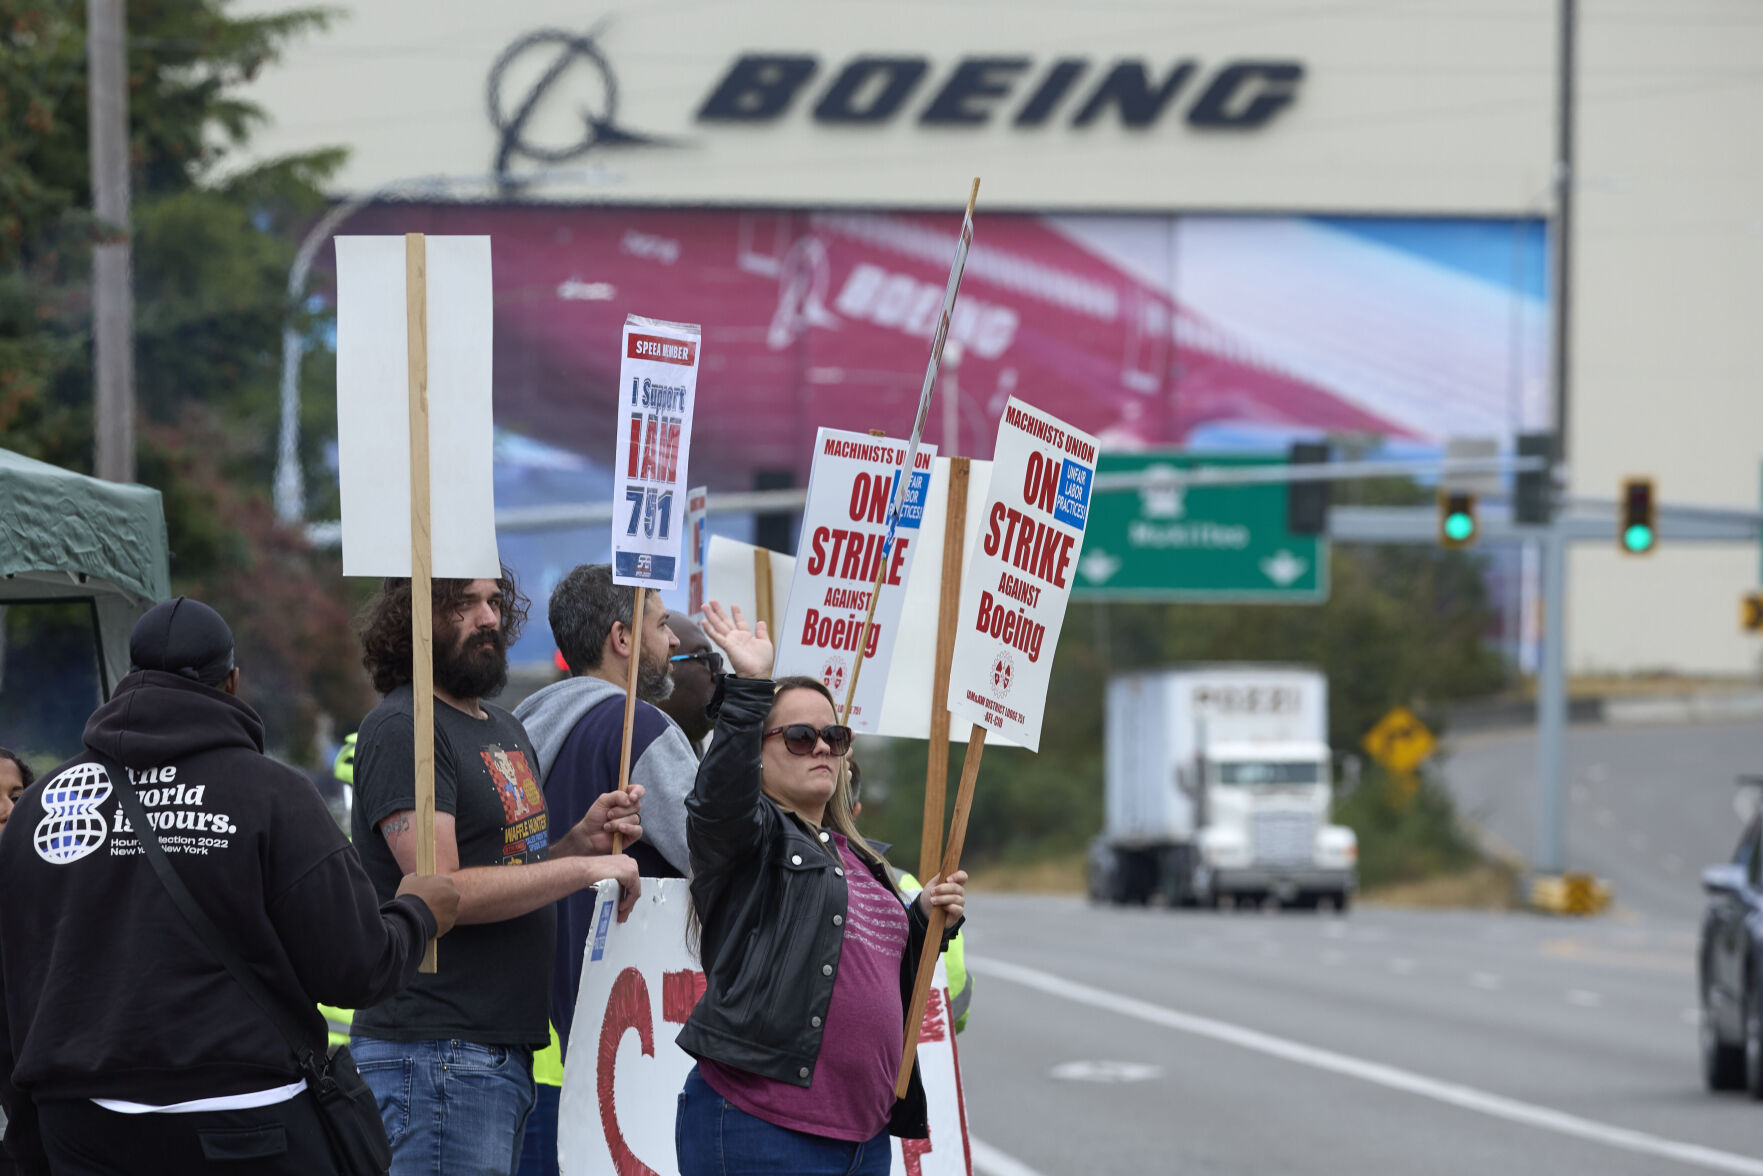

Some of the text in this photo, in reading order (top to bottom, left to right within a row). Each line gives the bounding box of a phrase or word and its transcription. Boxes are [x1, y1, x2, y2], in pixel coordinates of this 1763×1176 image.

[695, 52, 1305, 129] BOEING
[635, 340, 689, 360] SPEEA MEMBER
[631, 377, 687, 415] I Support
[1005, 405, 1095, 464] MACHINISTS UNION
[824, 439, 931, 470] MACHINISTS UON
[1023, 450, 1061, 515] ON
[1067, 464, 1087, 485] UNFAIR
[849, 472, 892, 525] ON
[1064, 480, 1083, 501] LABOR
[626, 485, 673, 540] 751
[1055, 494, 1087, 520] PRACTICES!
[983, 501, 1075, 590] STRIKE
[823, 587, 873, 611] AGAINST
[997, 571, 1042, 609] AGAINST
[975, 590, 1046, 663] Boeing
[985, 699, 1005, 716] DISTRICT
[146, 811, 237, 834] yours.
[110, 847, 136, 856] New
[183, 845, 208, 855] York
[198, 839, 229, 848] 2022
